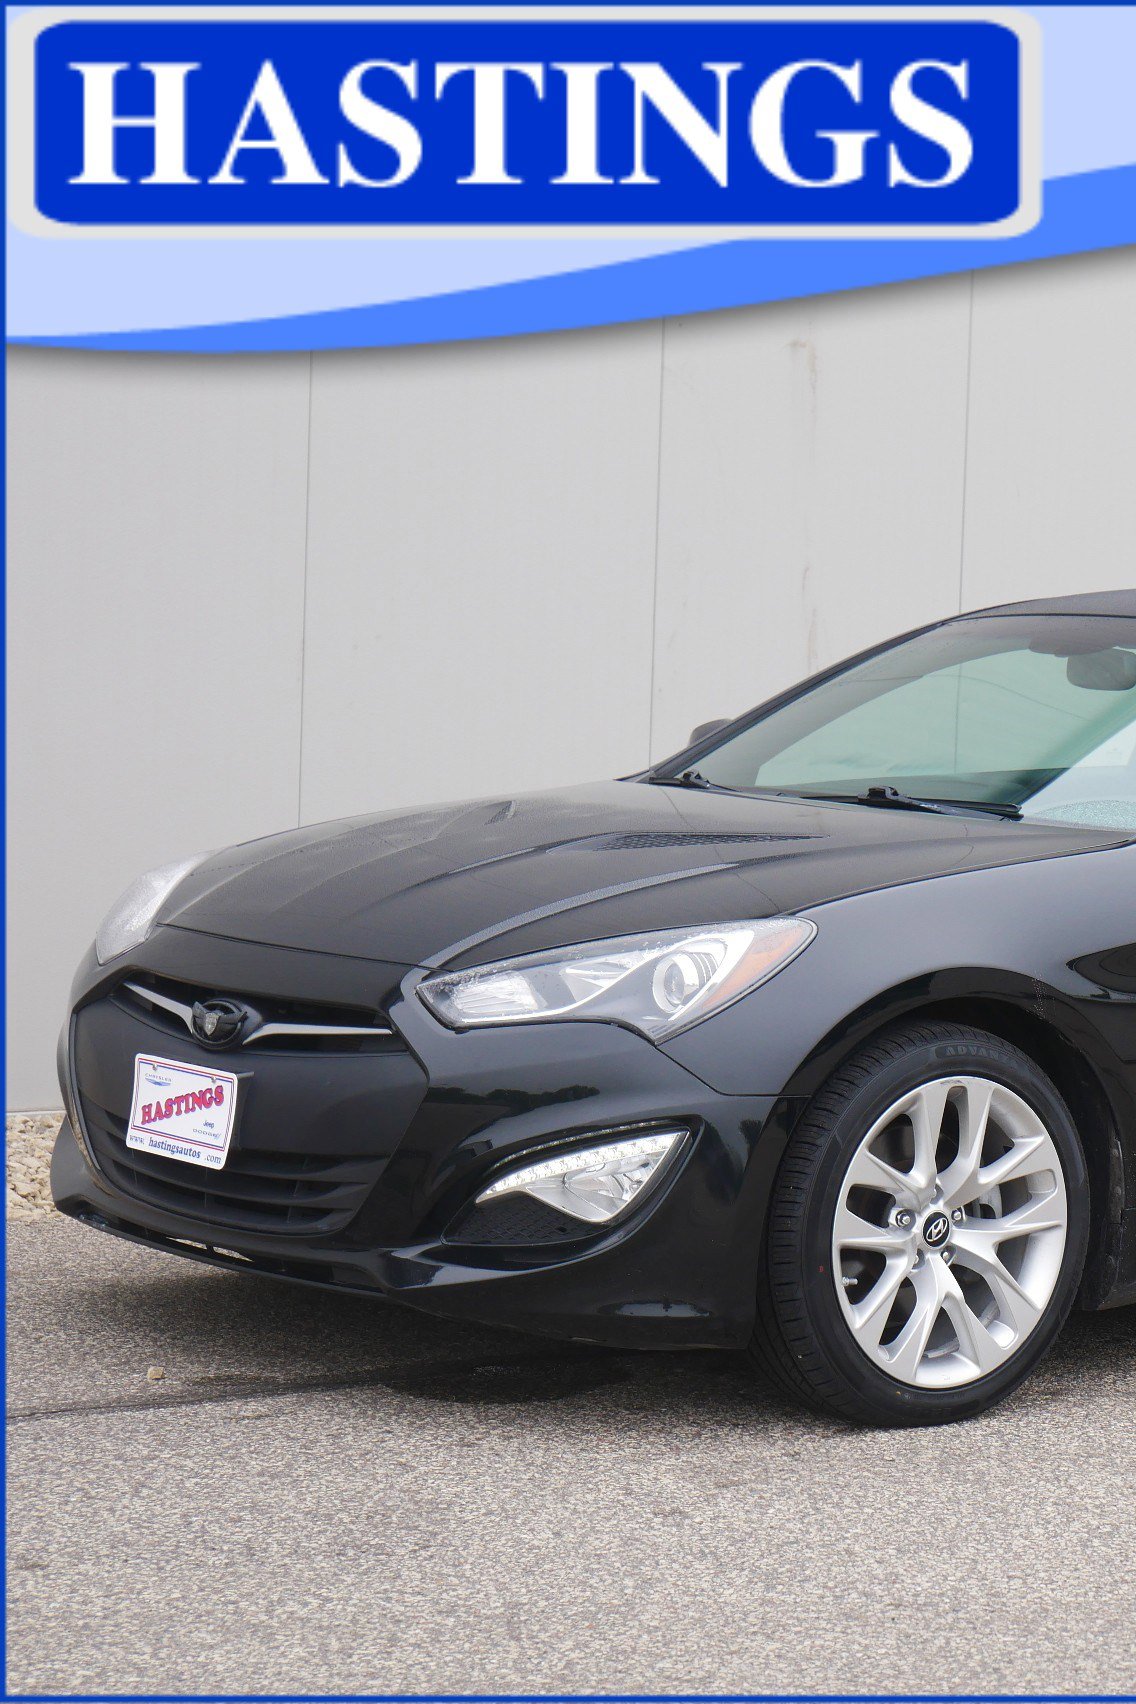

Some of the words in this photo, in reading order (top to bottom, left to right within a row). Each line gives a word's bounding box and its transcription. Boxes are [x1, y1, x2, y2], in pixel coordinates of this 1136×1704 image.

[141, 1085, 224, 1125] HASTINGS
[203, 1119, 215, 1129] Jeep
[148, 1136, 201, 1159] hastingsautos
